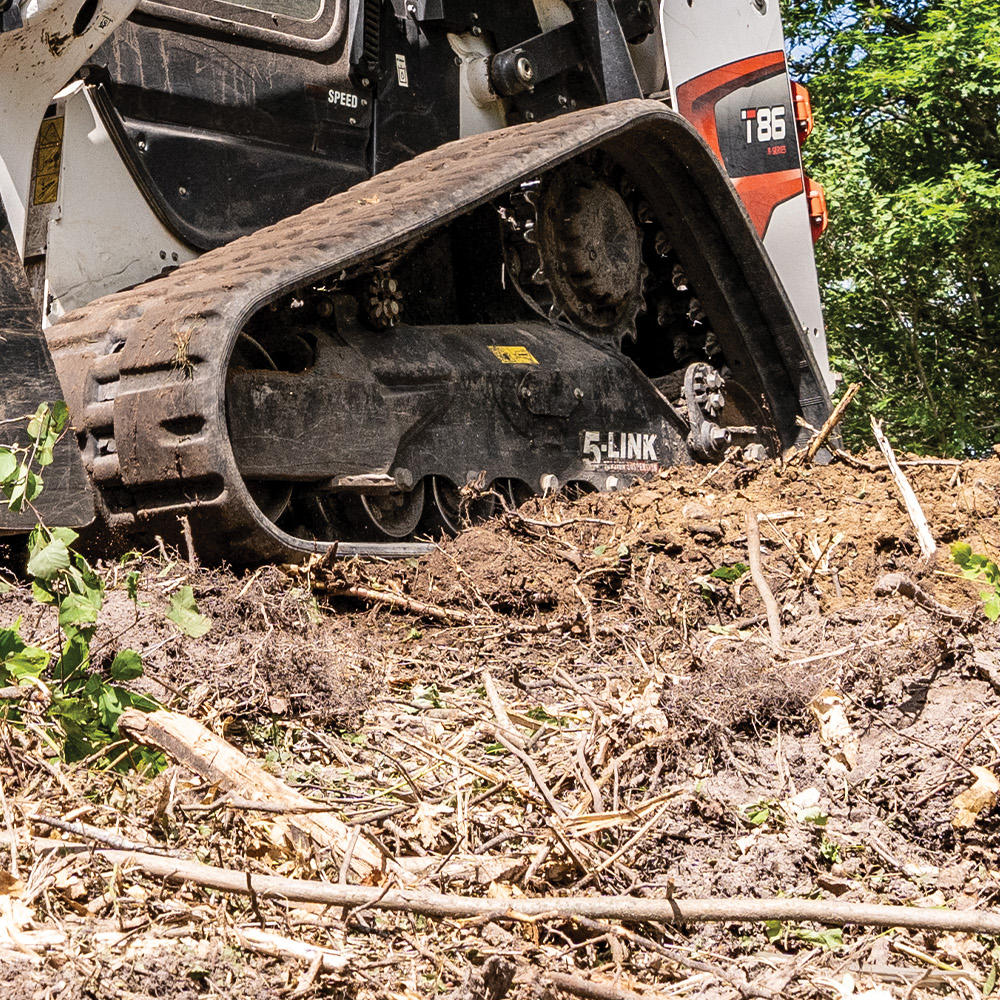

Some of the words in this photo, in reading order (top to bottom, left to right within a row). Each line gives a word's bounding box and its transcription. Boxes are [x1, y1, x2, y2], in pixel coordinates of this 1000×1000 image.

[328, 89, 358, 108] SPEED
[741, 106, 786, 143] T86
[582, 431, 657, 470] 5-LINK
